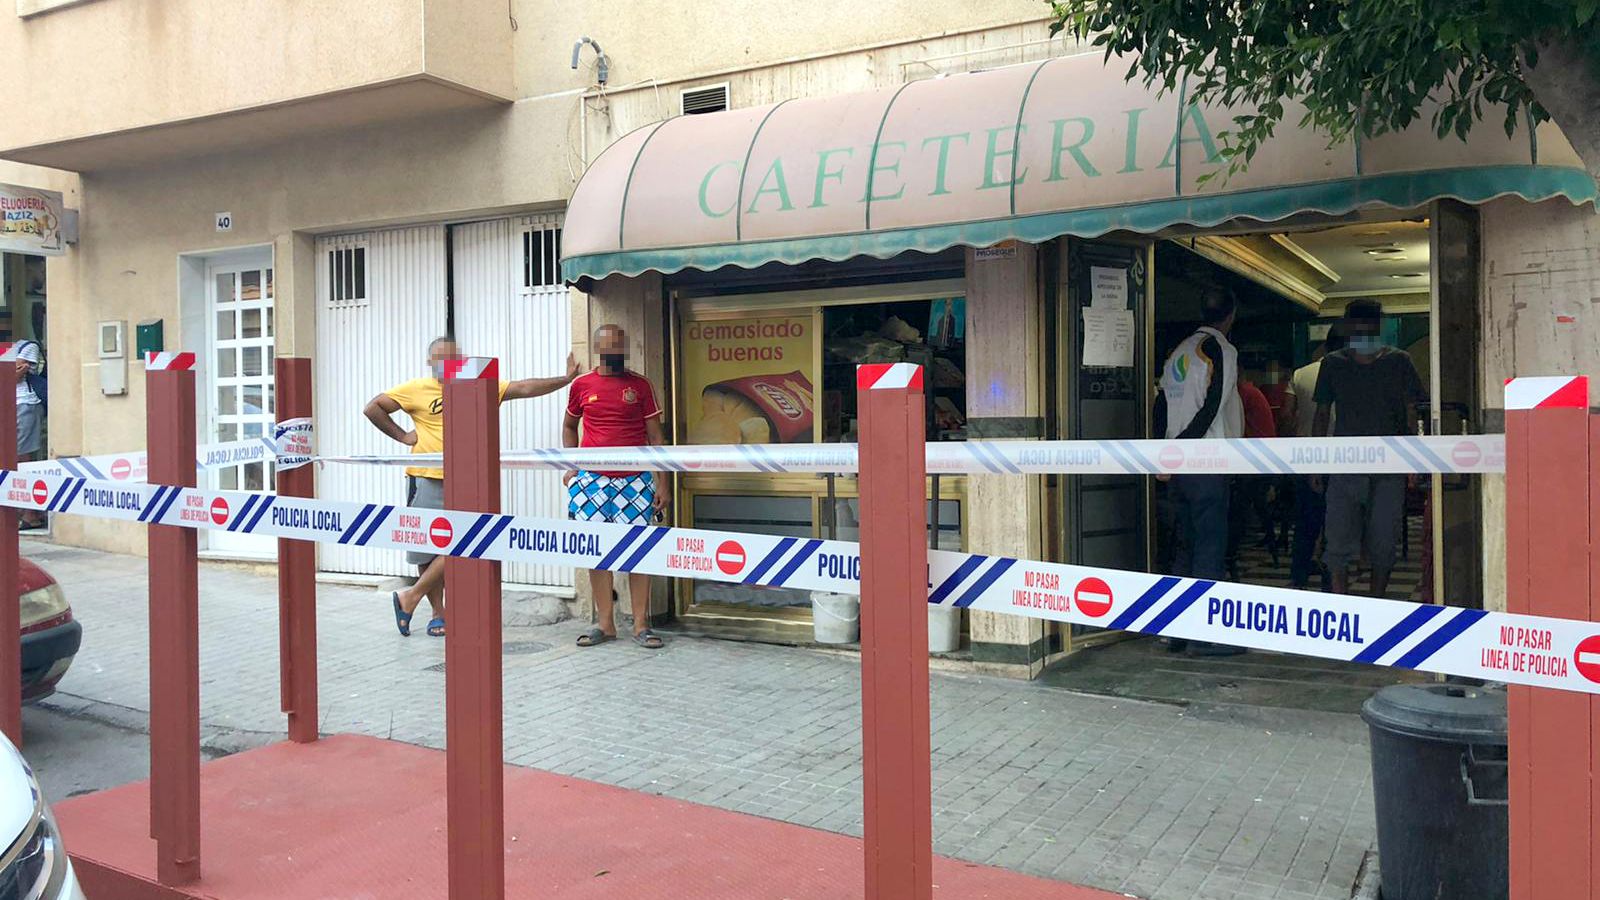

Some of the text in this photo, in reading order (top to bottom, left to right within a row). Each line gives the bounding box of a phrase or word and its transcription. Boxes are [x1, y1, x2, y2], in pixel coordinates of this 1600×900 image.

[699, 102, 1224, 219] CAFETERIA
[0, 197, 46, 211] ELUQUERIA
[7, 211, 33, 220] AZIZ
[218, 217, 230, 228] 40
[690, 319, 803, 340] demasiado
[708, 344, 783, 361] buenas
[84, 488, 141, 511] POLICIA LOCAL
[272, 506, 342, 532] POLICIA LOCAL
[399, 514, 421, 529] NO PASAR
[509, 528, 602, 557] POLICIA LOCAL
[677, 537, 705, 553] NO PASAR
[666, 554, 713, 572] LINEA DE POLICIA
[818, 553, 860, 580] POLIC
[1024, 570, 1060, 590] NO PASAR
[1012, 589, 1071, 612] LINEA DE POLICIA
[1208, 597, 1364, 644] POLICIA LOCAL
[1500, 625, 1552, 651] NO PASAR
[1481, 648, 1568, 677] LINEA DE POLICIA
